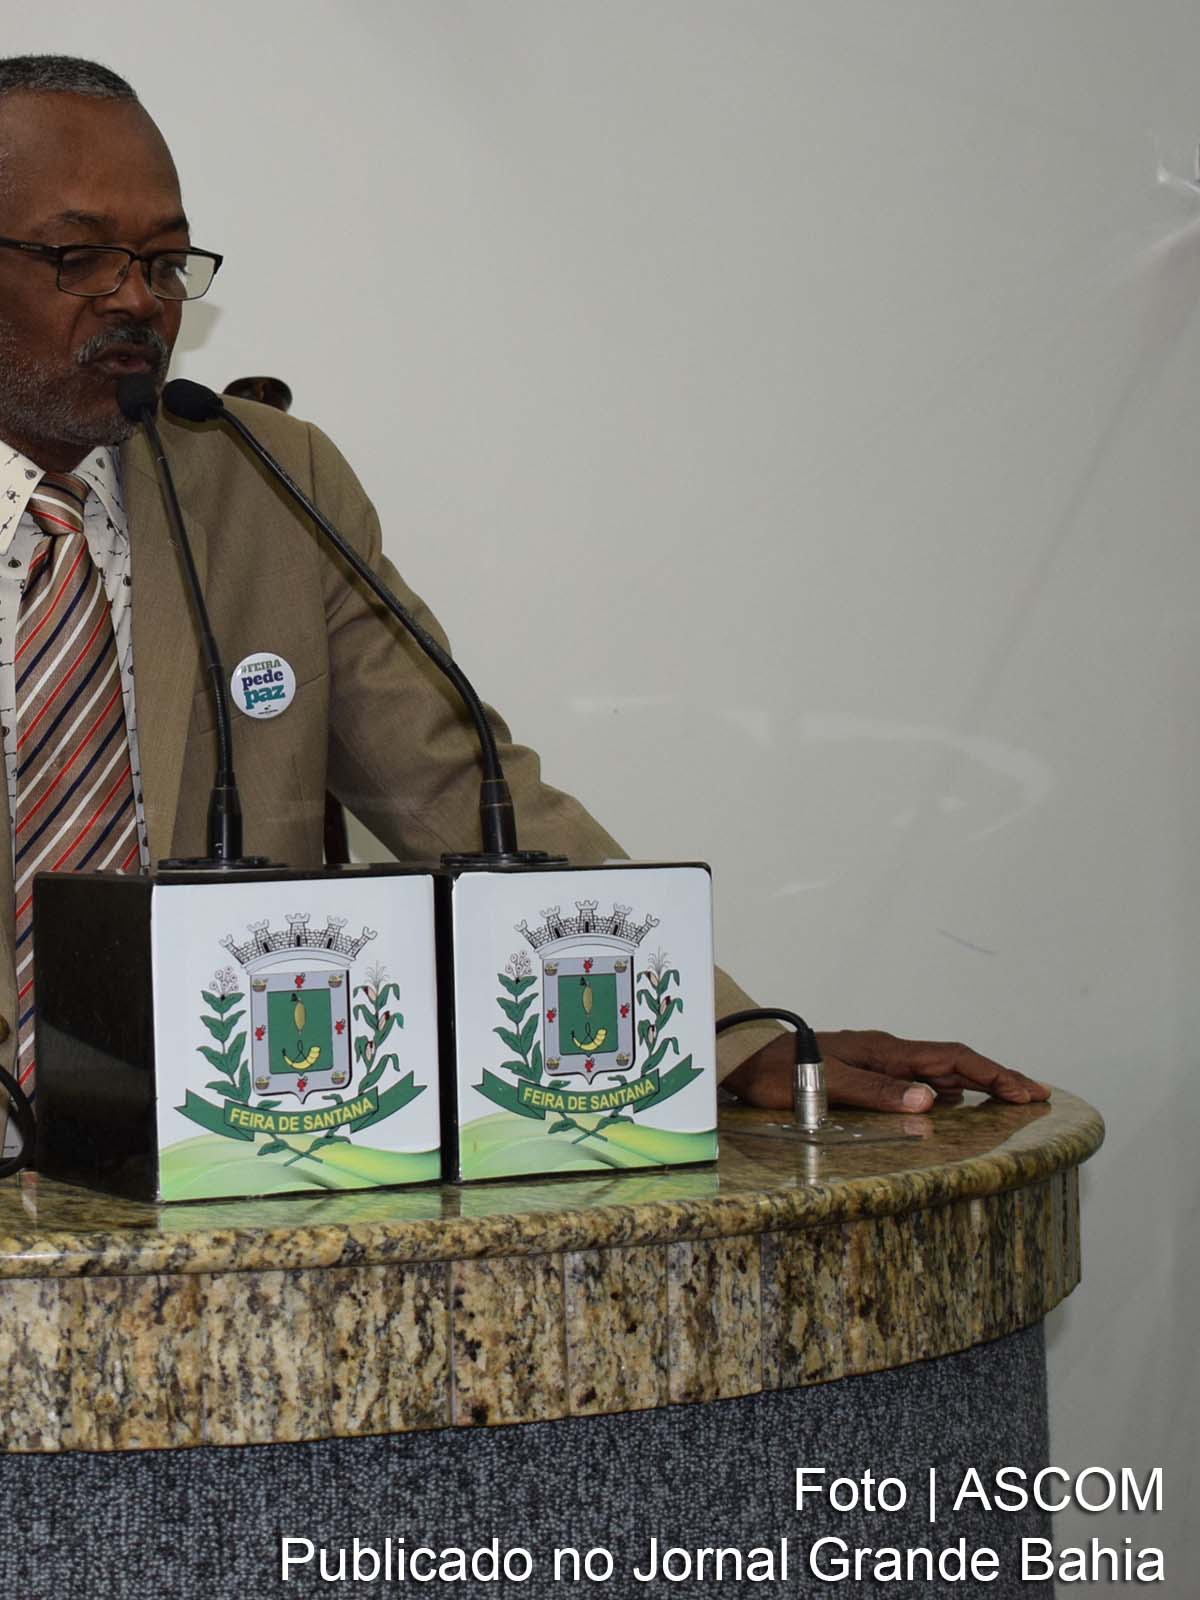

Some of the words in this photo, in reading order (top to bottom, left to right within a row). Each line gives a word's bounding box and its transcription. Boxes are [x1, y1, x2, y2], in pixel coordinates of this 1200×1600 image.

[241, 668, 284, 691] pede
[244, 684, 286, 710] paz
[523, 1087, 565, 1110] FEIRA
[567, 1096, 587, 1111] DE
[590, 1078, 656, 1109] SANTANA
[229, 1107, 275, 1131] FEIRA
[278, 1116, 300, 1132] DE
[303, 1097, 374, 1131] SANTANA
